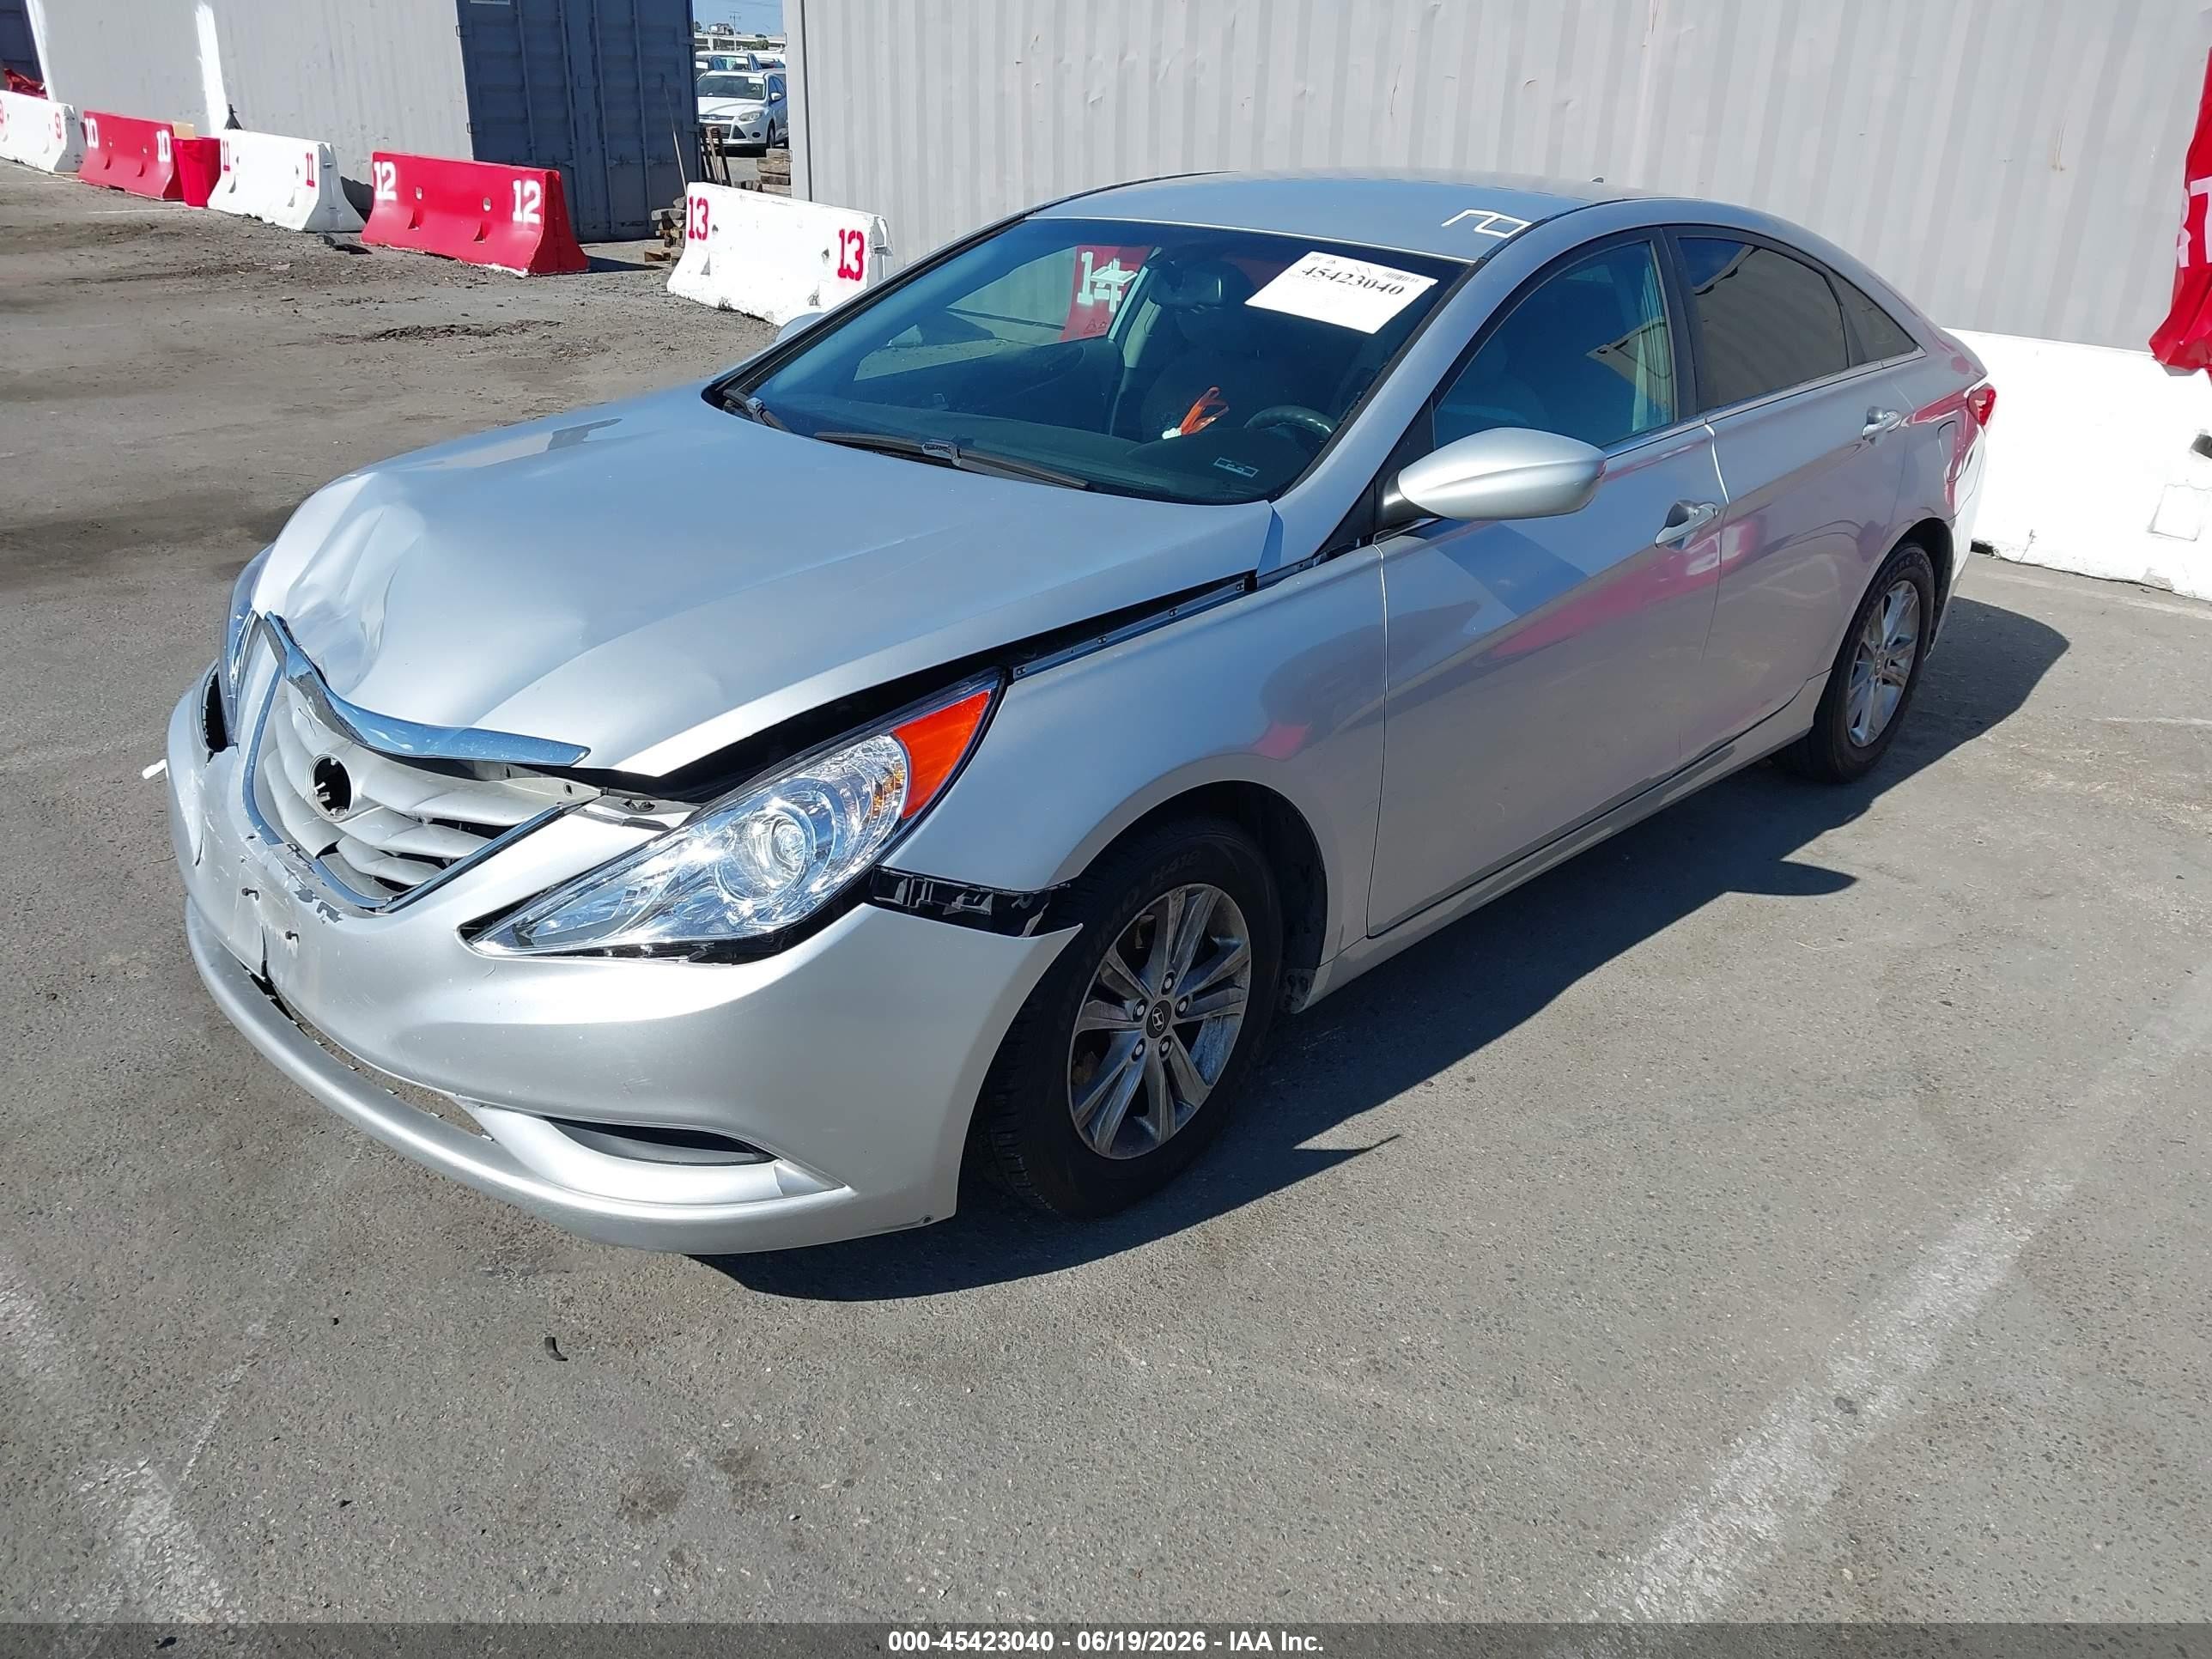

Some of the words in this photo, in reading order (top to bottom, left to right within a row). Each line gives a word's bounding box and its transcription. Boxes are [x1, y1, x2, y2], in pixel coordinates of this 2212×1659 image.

[84, 118, 100, 149] 10
[156, 129, 172, 163] 10
[222, 139, 231, 172] 11
[306, 151, 316, 188] 11
[373, 161, 398, 201] 12
[512, 179, 542, 224] 12
[688, 196, 709, 241] 13
[836, 228, 865, 282] 13
[1301, 266, 1406, 296] 45423040
